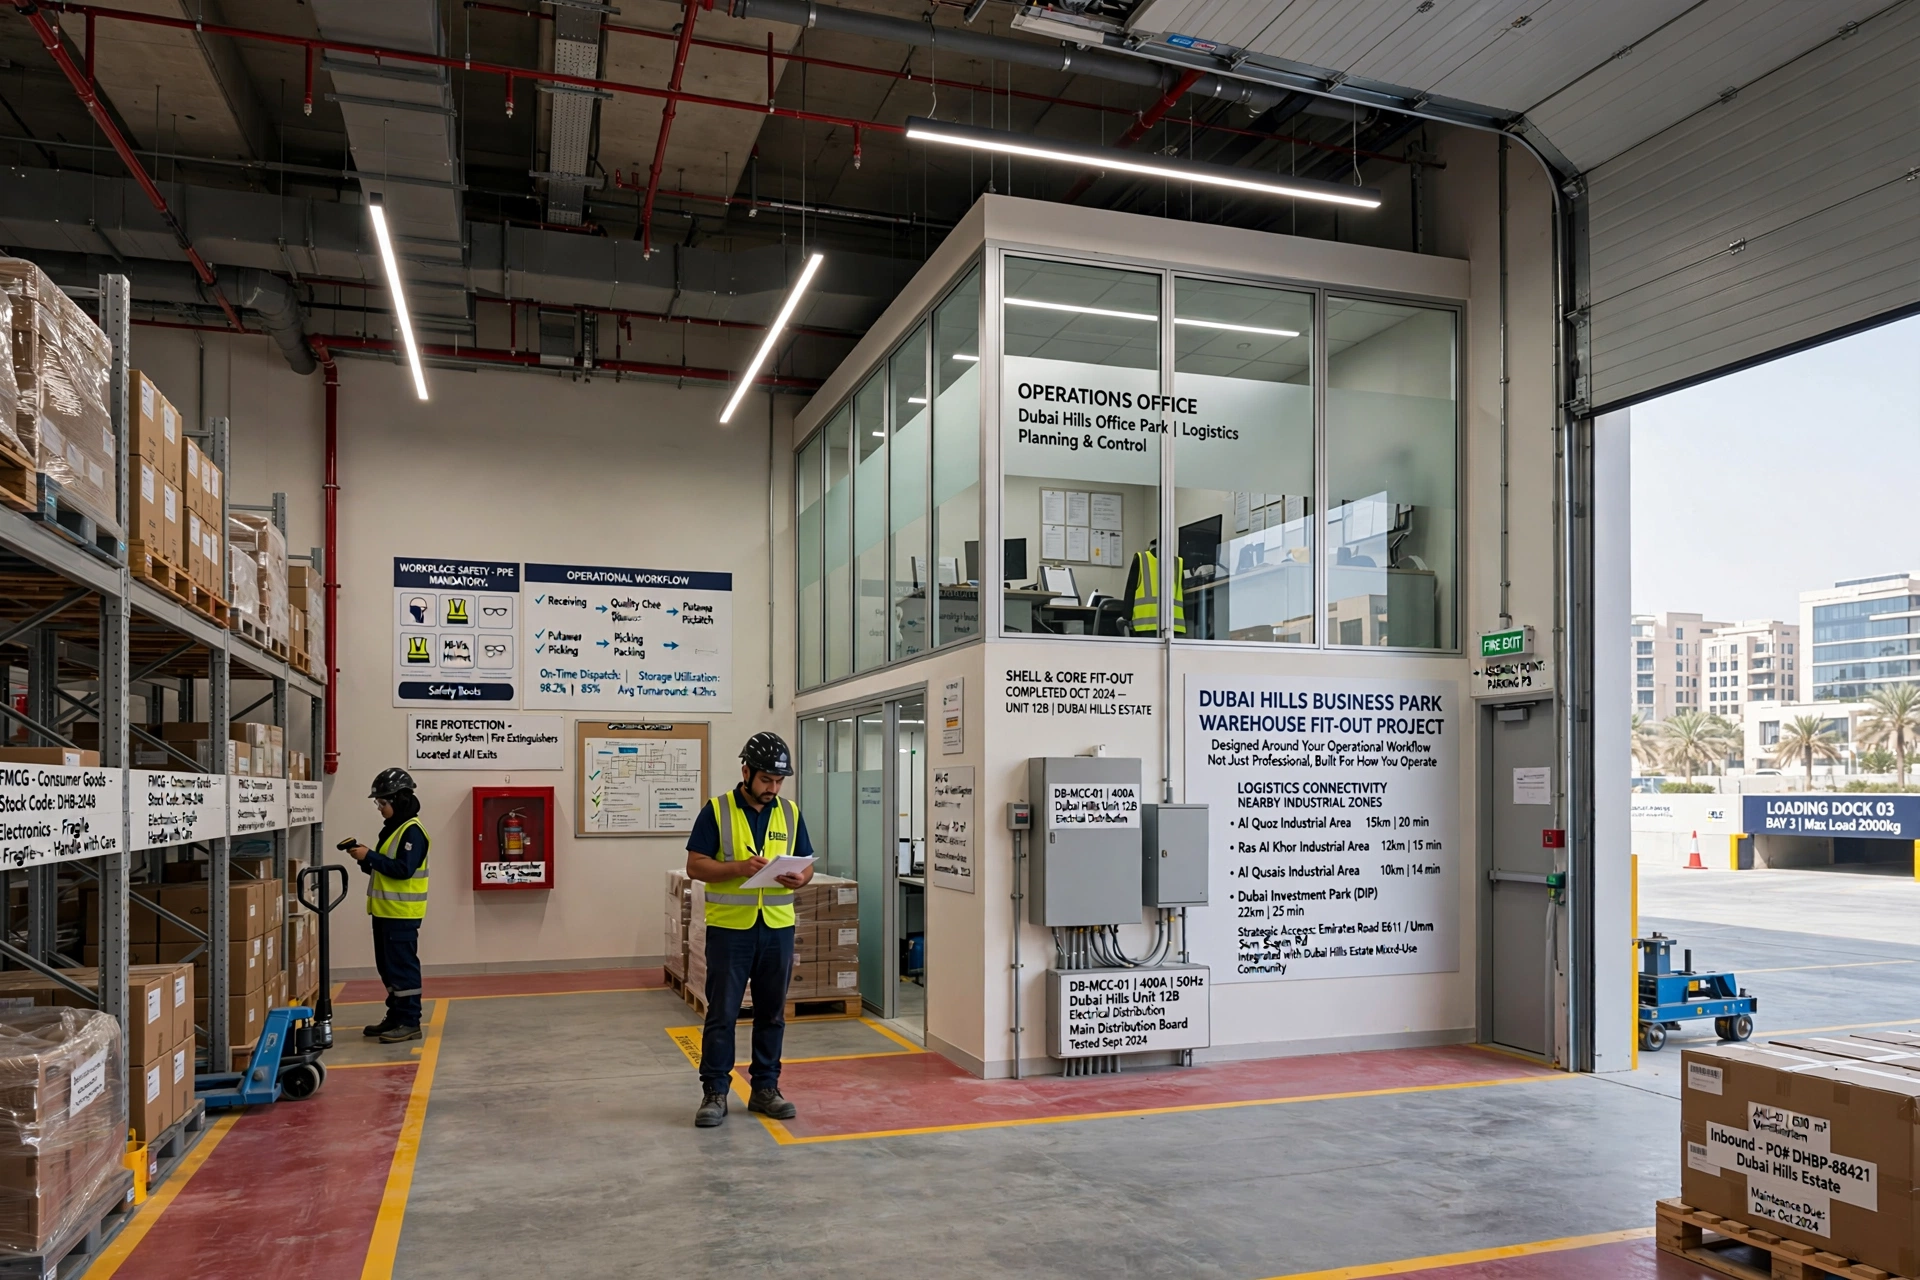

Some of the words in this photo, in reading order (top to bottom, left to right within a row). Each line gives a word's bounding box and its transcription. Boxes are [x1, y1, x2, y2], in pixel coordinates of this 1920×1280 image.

[1018, 382, 1132, 409] OPERATIONS
[1137, 394, 1197, 414] OFFICE
[1019, 408, 1058, 425] Dubai
[1063, 411, 1091, 428] Hills
[1095, 415, 1136, 431] Office
[1140, 419, 1168, 433] Park
[1182, 422, 1239, 441] Logistics
[1019, 429, 1078, 450] Planning
[1083, 434, 1093, 448] &
[1097, 435, 1147, 452] Control
[458, 566, 490, 576] SAFETY
[497, 568, 514, 576] PPE
[567, 570, 633, 583] OPERATIONAL
[635, 574, 690, 585] WORKFLOW
[548, 596, 587, 608] Receiving
[638, 671, 672, 683] Storage
[1006, 670, 1041, 682] SHELL
[1044, 671, 1053, 682] &
[1056, 671, 1087, 683] CORE
[1090, 672, 1134, 684] FIT-OUT
[581, 684, 600, 694] 85%
[1006, 686, 1067, 698] COMPLETED
[1070, 687, 1090, 699] OCT
[1092, 688, 1115, 699] 2024
[1006, 702, 1029, 713] UNIT
[1032, 703, 1048, 714] 12B
[1057, 703, 1087, 714] DUBAI
[1090, 704, 1116, 715] HILLS
[1118, 704, 1152, 715] ESTATE
[1199, 690, 1254, 708] DUBAI
[1260, 691, 1308, 709] HILLS
[1313, 693, 1394, 711] BUSINESS
[1399, 695, 1442, 712] PARK
[416, 719, 438, 729] FIRE
[440, 720, 505, 730] PROTECTION
[1199, 715, 1306, 733] WAREHOUSE
[1311, 716, 1372, 733] FIT-OUT
[1377, 718, 1444, 735] PROJECT
[455, 733, 484, 744] System
[491, 733, 505, 742] Fire
[416, 749, 450, 759] Located
[452, 750, 461, 759] at
[463, 749, 475, 759] All
[477, 750, 498, 759] Exits
[1211, 739, 1259, 753] Designed
[1262, 739, 1299, 752] Around
[1302, 740, 1325, 752] Your
[1327, 740, 1384, 754] Operational
[1386, 740, 1431, 753] Workflow
[1208, 754, 1227, 766] Not
[1228, 755, 1249, 766] Just
[1252, 755, 1313, 768] Professional,
[1315, 755, 1336, 767] Built
[1340, 756, 1354, 766] For
[1357, 756, 1379, 766] How
[1381, 756, 1398, 766] You
[1400, 756, 1437, 770] Operate
[38, 770, 81, 787] Consumer
[1112, 788, 1134, 798] 400A
[1238, 782, 1299, 794] LOGISTICS
[1303, 782, 1387, 794] CONNECTIVITY
[29, 793, 55, 811] Code:
[1238, 797, 1281, 808] NEARBY
[1284, 797, 1345, 808] INDUSTRIAL
[1348, 797, 1382, 808] ZONES
[1766, 801, 1828, 816] LOADING
[1832, 802, 1873, 816] DOCK
[1876, 802, 1895, 816] 03
[1238, 817, 1248, 828] Al
[1251, 818, 1278, 830] Quoz
[1281, 817, 1327, 828] Industrial
[1329, 817, 1351, 828] Area
[1366, 817, 1391, 828] 15km
[1398, 816, 1410, 827] 20
[1413, 816, 1429, 827] min
[1766, 817, 1787, 829] BAY
[1789, 818, 1796, 829] 3
[1804, 818, 1826, 832] Max
[1829, 818, 1856, 832] Load
[1858, 818, 1901, 835] 2000kg
[100, 835, 116, 850] Care
[1238, 841, 1256, 853] Ras
[1259, 841, 1269, 853] Al
[1273, 841, 1297, 853] Khor
[1300, 841, 1345, 852] Industrial
[1348, 841, 1370, 852] Area
[1381, 840, 1405, 851] 12km
[1413, 840, 1423, 850] 15
[1426, 840, 1442, 850] min
[1238, 866, 1248, 878] Al
[1251, 865, 1286, 879] Qusais
[1289, 865, 1334, 877] Industrial
[1337, 865, 1360, 876] Area
[1380, 864, 1404, 876] 10km
[1412, 864, 1423, 875] 14
[1425, 863, 1441, 875] min
[1238, 890, 1268, 902] Dubai
[1271, 889, 1326, 901] Investment
[1329, 888, 1351, 900] Park
[1354, 887, 1378, 901] (DIP)
[1238, 906, 1264, 918] 22km
[1272, 905, 1284, 917] 25
[1287, 905, 1304, 916] min
[1381, 921, 1401, 932] E611
[1237, 963, 1287, 975] Community
[1070, 979, 1129, 992] DB-MCC-01
[1140, 977, 1167, 988] 400A
[1176, 976, 1203, 987] 50Hz
[1070, 994, 1102, 1006] Dubai
[1106, 993, 1129, 1004] Hills
[1132, 991, 1156, 1003] Unit
[1160, 991, 1180, 1002] 12B
[1070, 1023, 1095, 1035] Main
[1098, 1020, 1156, 1034] Distribution
[1159, 1017, 1188, 1030] Board
[1069, 1038, 1100, 1049] Tested
[1103, 1037, 1122, 1049] Sept
[1126, 1035, 1148, 1046] 2024
[1710, 1128, 1755, 1151] Inbound
[1766, 1142, 1790, 1159] PO#
[1792, 1149, 1870, 1182] DHBP-88421
[1736, 1153, 1769, 1174] Dubai
[1773, 1161, 1798, 1181] Hills
[1801, 1171, 1841, 1194] Estate
